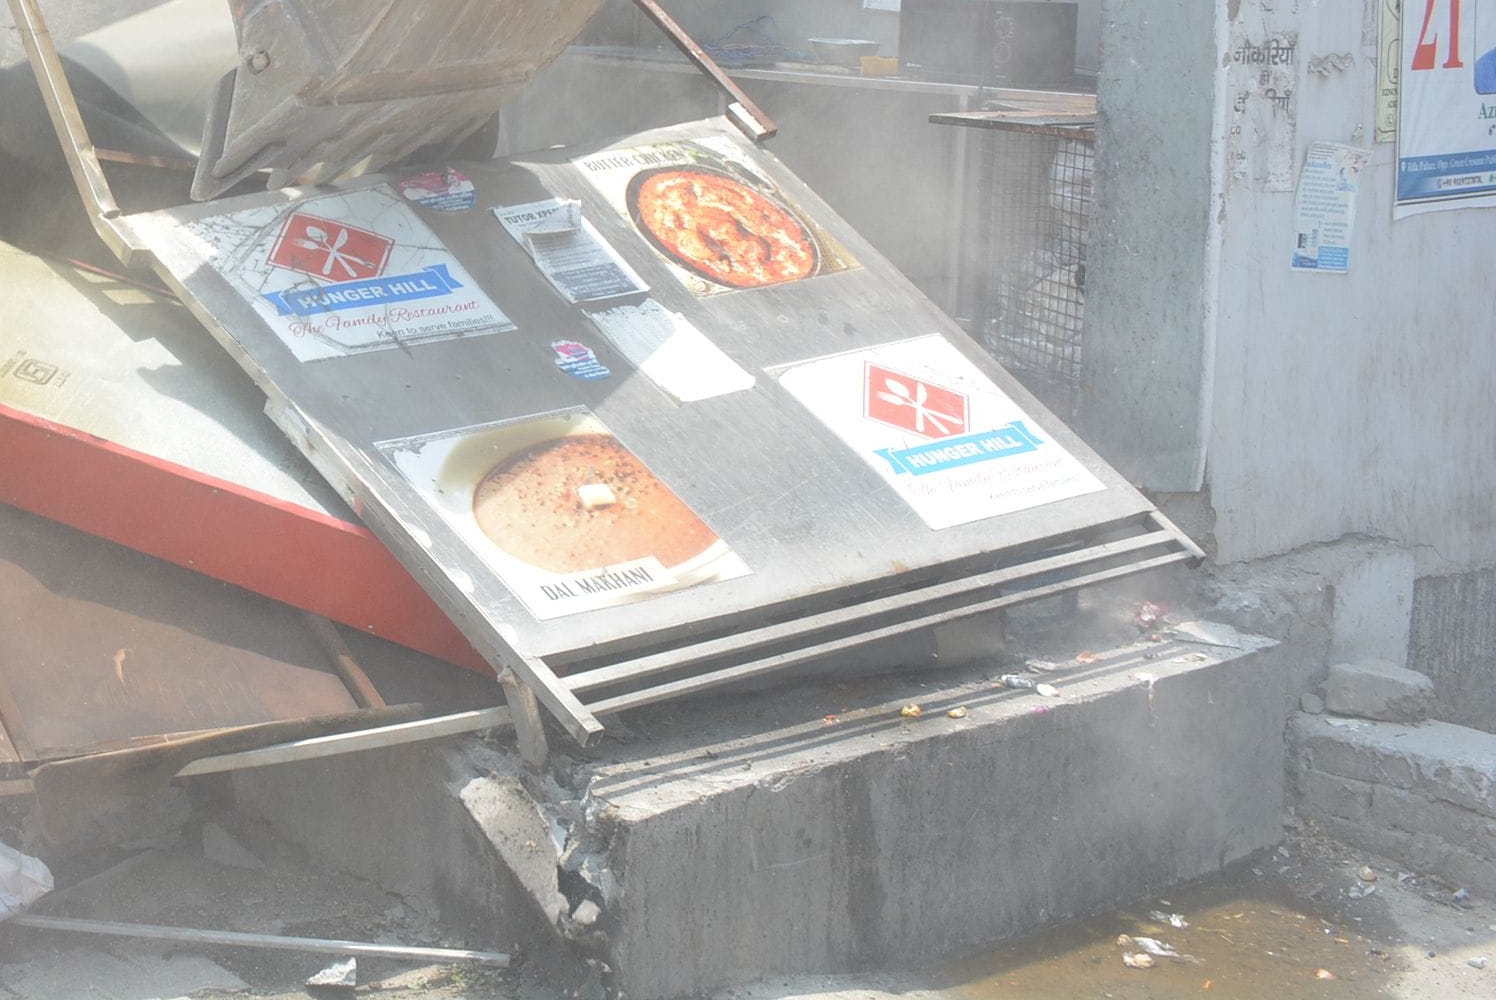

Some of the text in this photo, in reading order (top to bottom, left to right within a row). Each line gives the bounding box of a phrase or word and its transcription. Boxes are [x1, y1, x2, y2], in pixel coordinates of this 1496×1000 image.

[583, 148, 688, 172] BUTTER CHICKEN
[504, 212, 535, 225] TUTOR
[297, 278, 438, 310] HUNGER HILL
[289, 300, 480, 338] The Family Restaurant
[377, 329, 406, 340] Keen
[406, 326, 418, 336] to
[419, 322, 446, 334] serve
[905, 433, 1025, 469] HUNGER HILL
[540, 566, 654, 601] DAL MAKHANI
